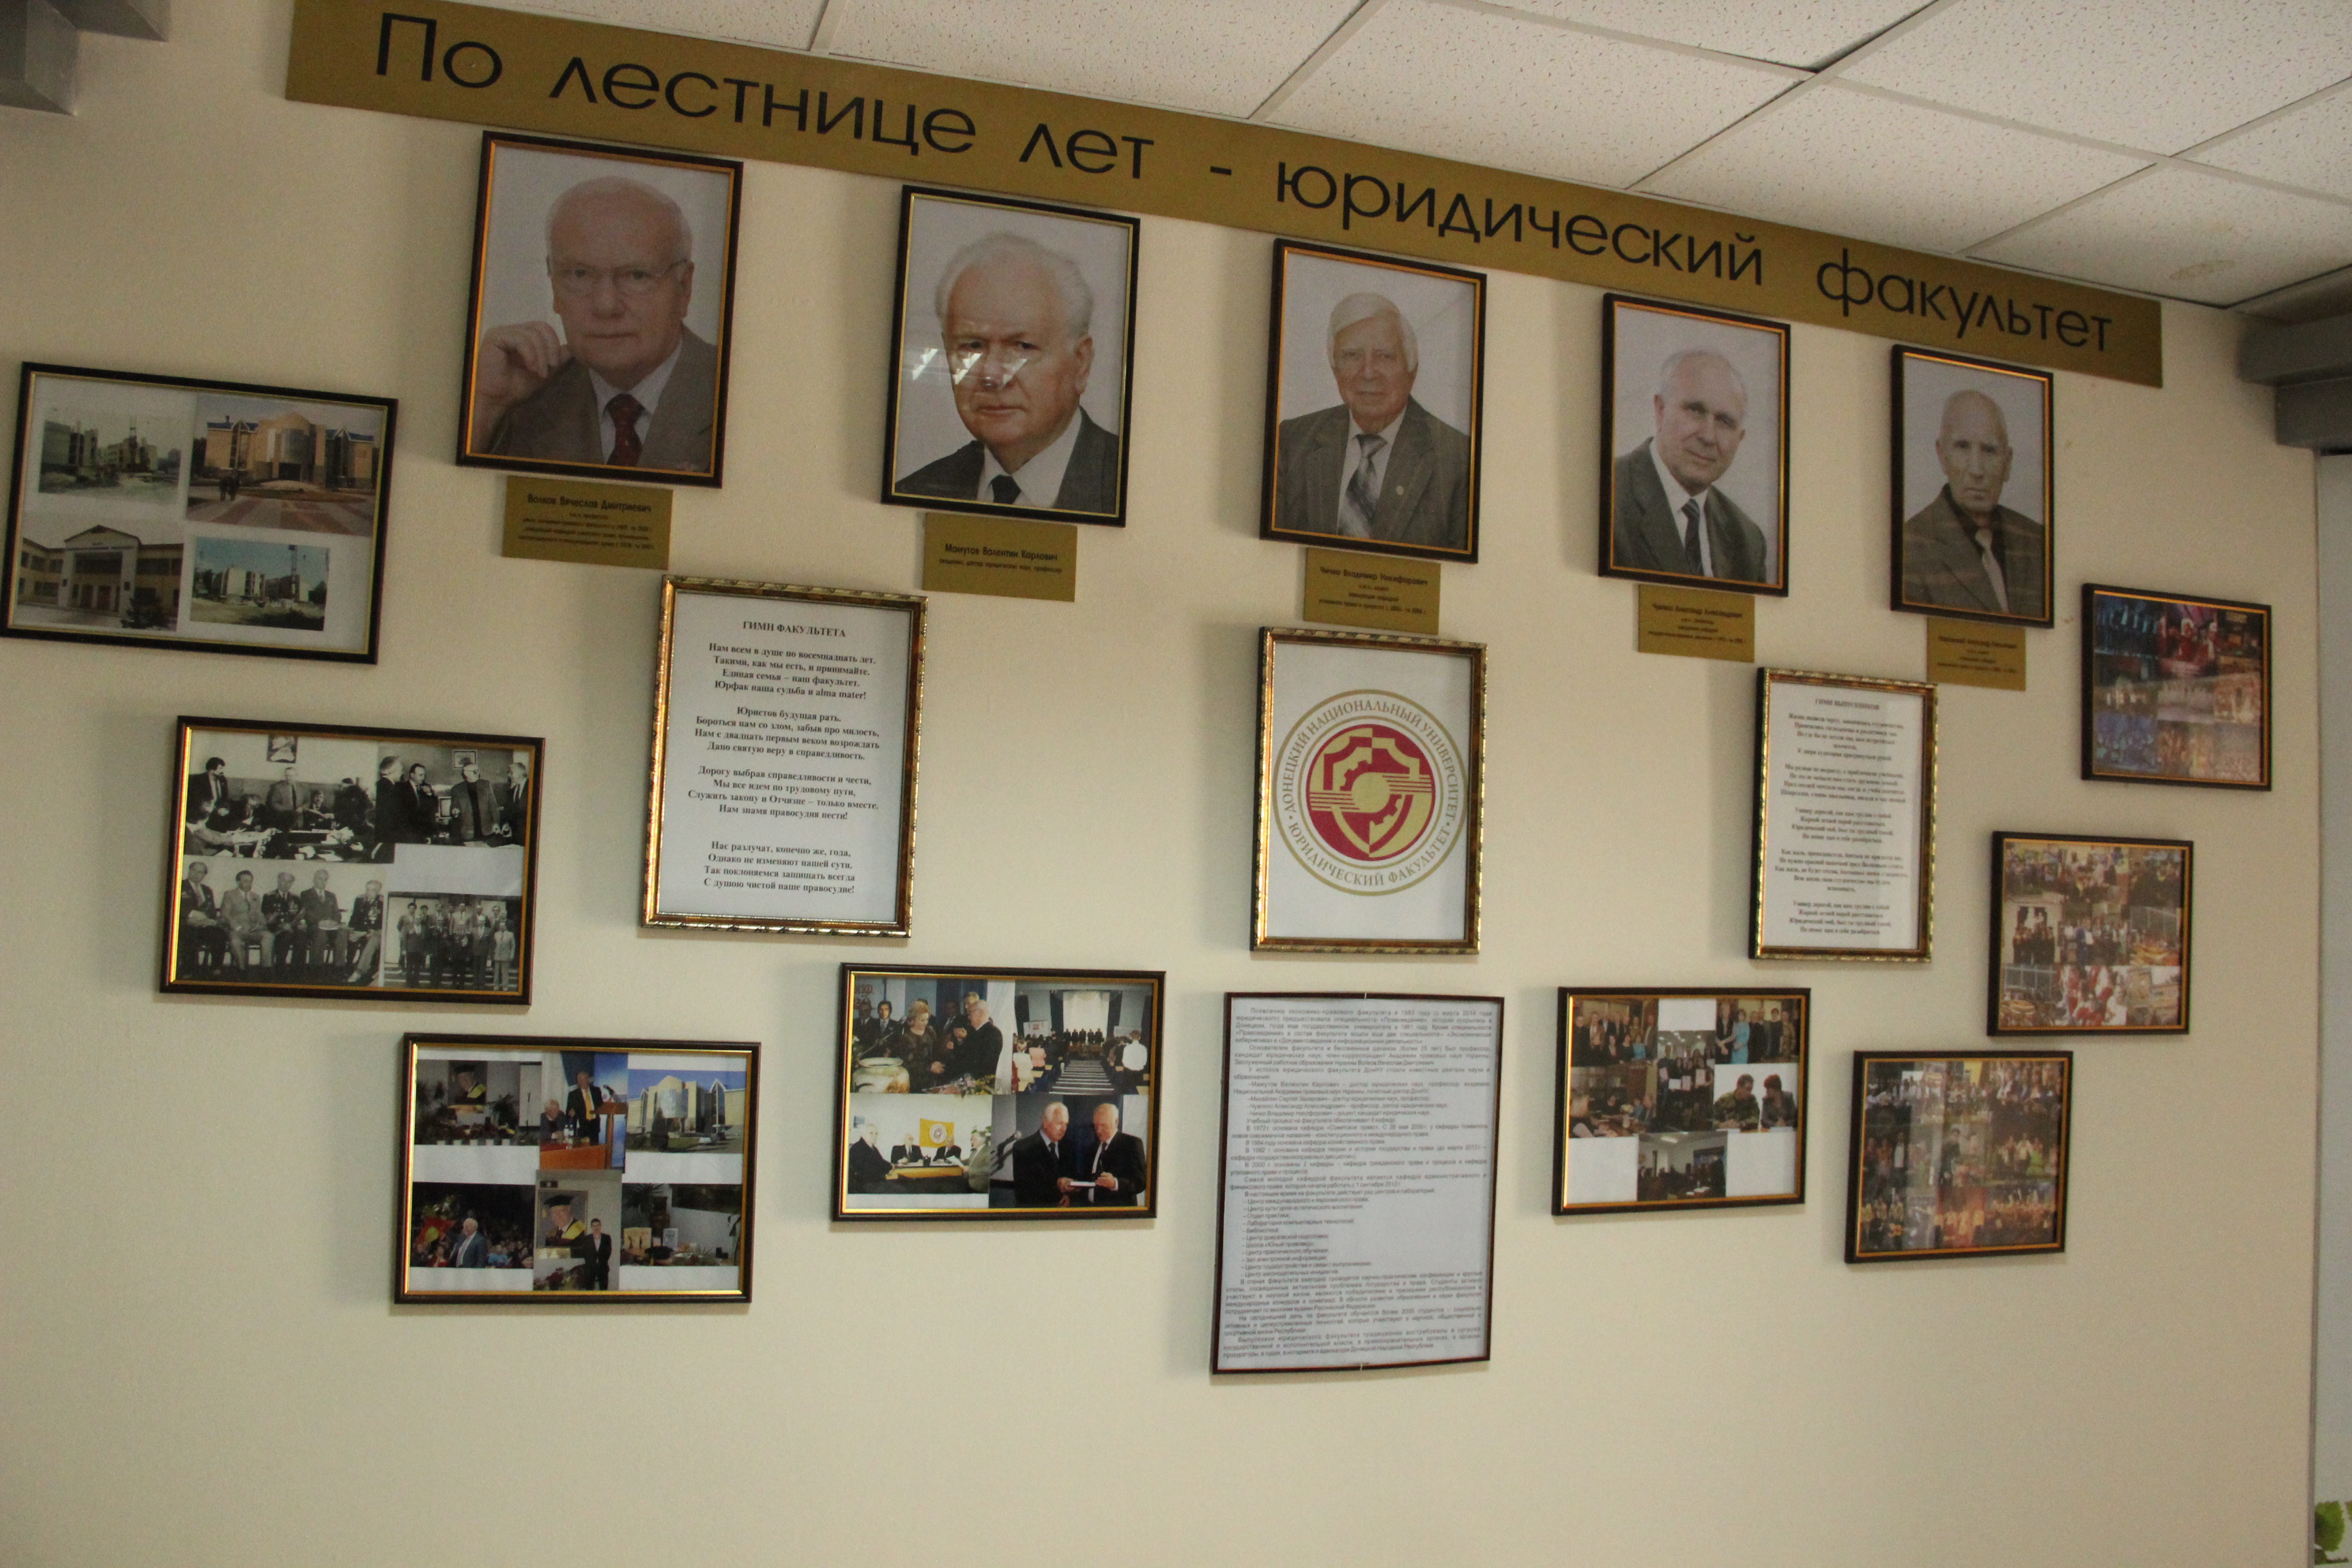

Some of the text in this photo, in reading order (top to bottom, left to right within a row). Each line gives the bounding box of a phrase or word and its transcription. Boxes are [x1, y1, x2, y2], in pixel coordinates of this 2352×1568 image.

[374, 12, 503, 89] По
[547, 56, 976, 156] лестнице
[1019, 123, 1154, 179] лет
[1277, 162, 1762, 286] юридический
[1816, 248, 2112, 351] факультет
[527, 493, 651, 512] Волков Вячеслав Дмитриевич
[945, 544, 979, 556] Мамутов
[983, 546, 1018, 558] Валентин
[742, 620, 846, 638] ГИМН ФАКУЛЬТЕТА
[708, 642, 729, 652] Нам
[730, 646, 751, 654] всем
[760, 649, 783, 657] душе
[798, 651, 858, 662] восемнадцать
[858, 656, 876, 664] лет.
[721, 668, 754, 679] Единая
[755, 672, 781, 681] семья
[791, 675, 810, 683] наш
[811, 675, 860, 687] факультет.
[768, 661, 783, 669] мы
[815, 665, 870, 676] принимайте.
[714, 679, 749, 692] Юрфак
[750, 684, 774, 693] наша
[776, 686, 806, 696] судьба
[815, 687, 836, 698] alma
[838, 691, 866, 700] mater!
[736, 706, 777, 718] Юристов
[779, 709, 817, 721] будущая
[695, 715, 736, 727] Бороться
[738, 720, 756, 728] нам
[770, 723, 794, 732] злом,
[796, 723, 822, 733] забыв
[823, 726, 840, 736] про
[842, 728, 879, 738] милость,
[694, 727, 715, 738] Нам
[765, 734, 800, 744] первым
[801, 737, 828, 745] веком
[829, 739, 880, 749] возрождать
[706, 740, 731, 751] Дано
[732, 745, 764, 755] святую
[766, 747, 786, 757] веру
[795, 749, 865, 760] справедливость.
[1283, 700, 1458, 822] ДОНЕЦКИЙ НАЦИОНАЛЬНЫЙ УНИВЕРСИТЕТ
[697, 765, 731, 778] Дорогу
[732, 768, 766, 779] выбрав
[767, 772, 836, 783] справедливости
[845, 777, 872, 786] чести,
[713, 778, 730, 788] Мы
[748, 783, 770, 791] идем
[784, 785, 831, 796] трудовому
[832, 788, 855, 797] пути,
[687, 789, 728, 801] Служить
[730, 794, 759, 804] закону
[768, 794, 806, 805] Отчизне
[816, 799, 845, 808] только
[847, 801, 879, 810] вместе.
[718, 803, 739, 813] Нам
[769, 808, 819, 819] правосудия
[821, 811, 848, 820] нести!
[710, 840, 729, 850] Нас
[775, 846, 811, 855] конечно
[812, 848, 827, 856] же,
[829, 849, 851, 858] года,
[1288, 821, 1450, 886] ЮРИДИЧЕСКИЙ ФАКУЛЬТЕТ
[707, 852, 742, 863] Однако
[800, 859, 829, 868] нашей
[703, 864, 721, 875] Так
[827, 873, 855, 881] всегда
[703, 877, 855, 895] С душою чистой наше правосудие!
